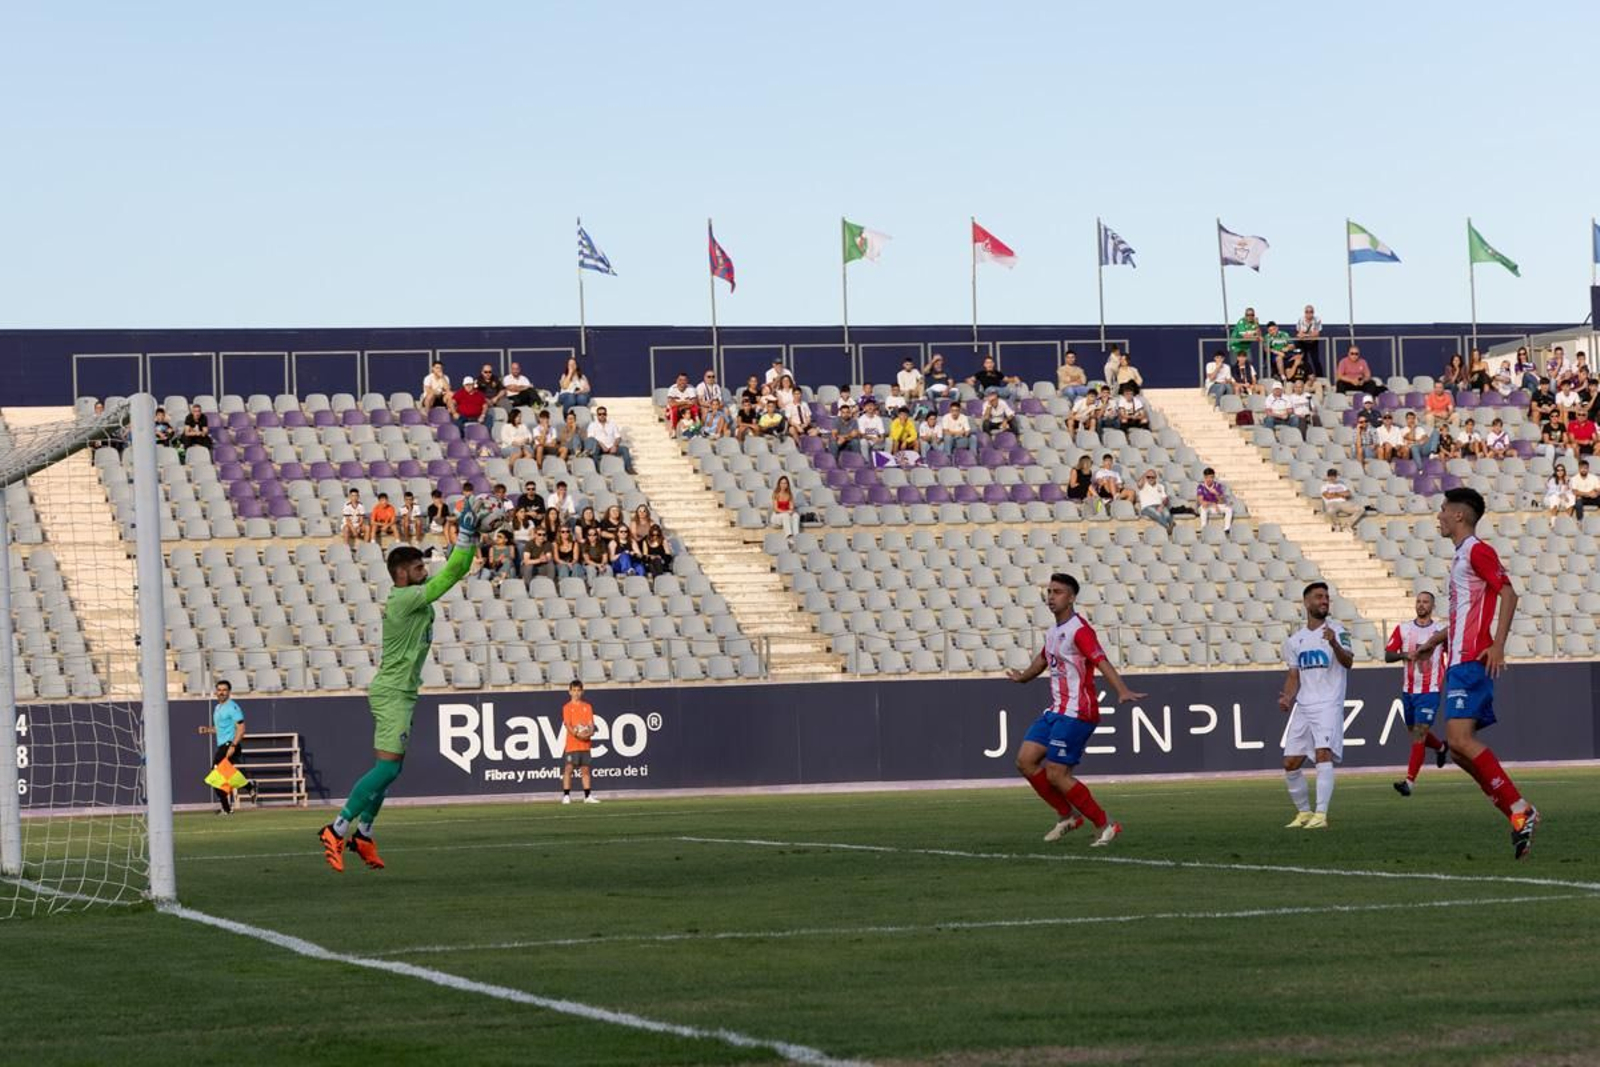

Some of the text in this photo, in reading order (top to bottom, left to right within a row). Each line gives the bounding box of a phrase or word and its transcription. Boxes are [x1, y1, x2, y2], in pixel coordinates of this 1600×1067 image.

[484, 768, 515, 781] Fibra
[516, 771, 526, 783] y
[526, 767, 564, 780] móvil,
[591, 767, 622, 778] cerca
[623, 764, 638, 777] de
[639, 764, 649, 777] ti
